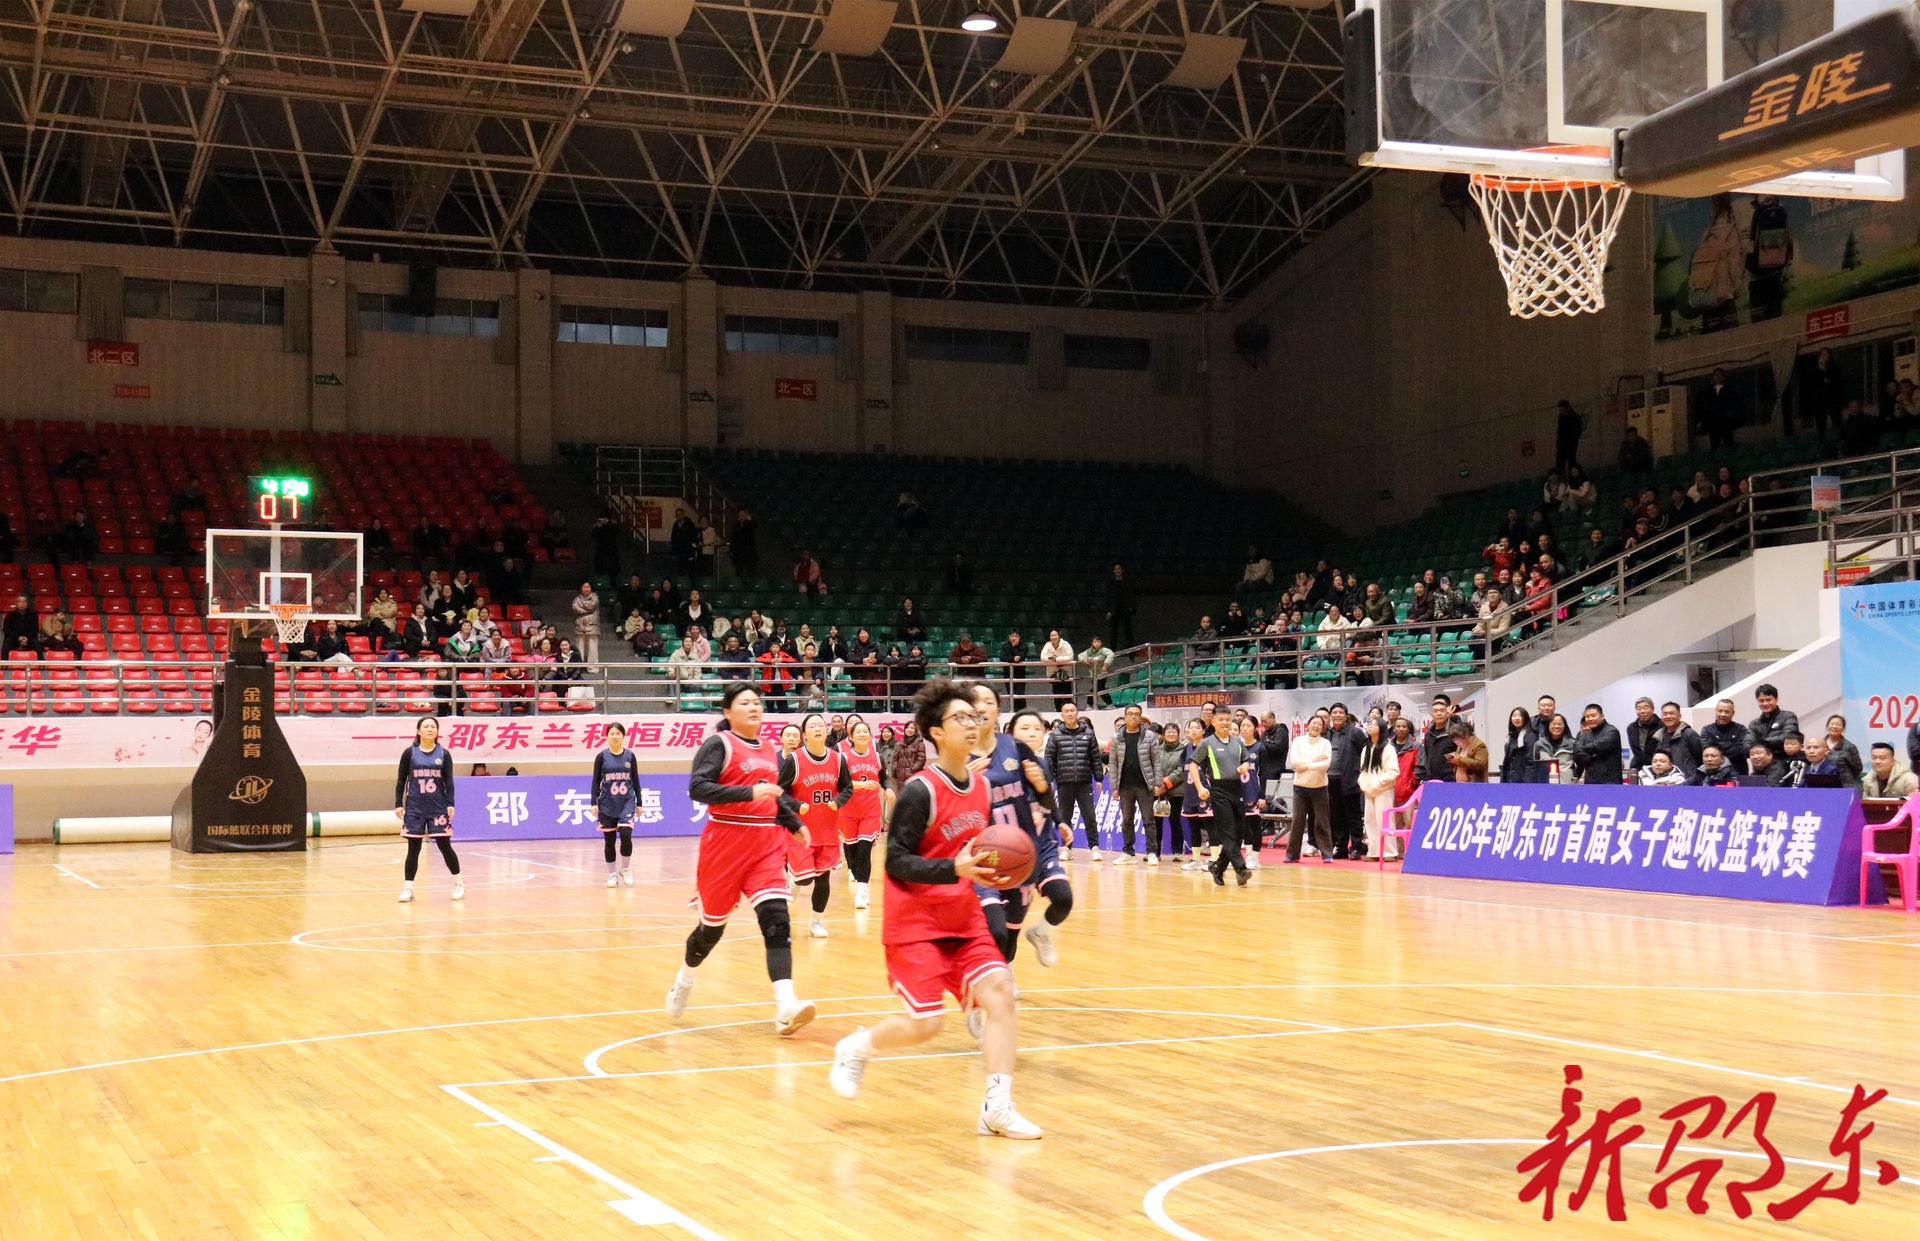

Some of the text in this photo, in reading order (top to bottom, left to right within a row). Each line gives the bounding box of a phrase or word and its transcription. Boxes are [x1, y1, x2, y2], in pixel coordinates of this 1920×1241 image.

[1718, 51, 1891, 141] 金陵
[1809, 310, 1847, 333] 东三区
[90, 349, 136, 365] 北二区
[778, 381, 814, 396] 北一区
[260, 494, 298, 520] 07
[1868, 599, 1920, 612] 中国体育彩
[242, 687, 262, 758] 金陵体育
[0, 725, 62, 756] 华
[418, 778, 437, 794] 16
[610, 781, 628, 796] 66
[812, 789, 831, 805] 68
[207, 824, 293, 836] 国际篮联合作伙伴
[1421, 802, 1823, 880] 2026年邵东市首届女子趣味篮球赛
